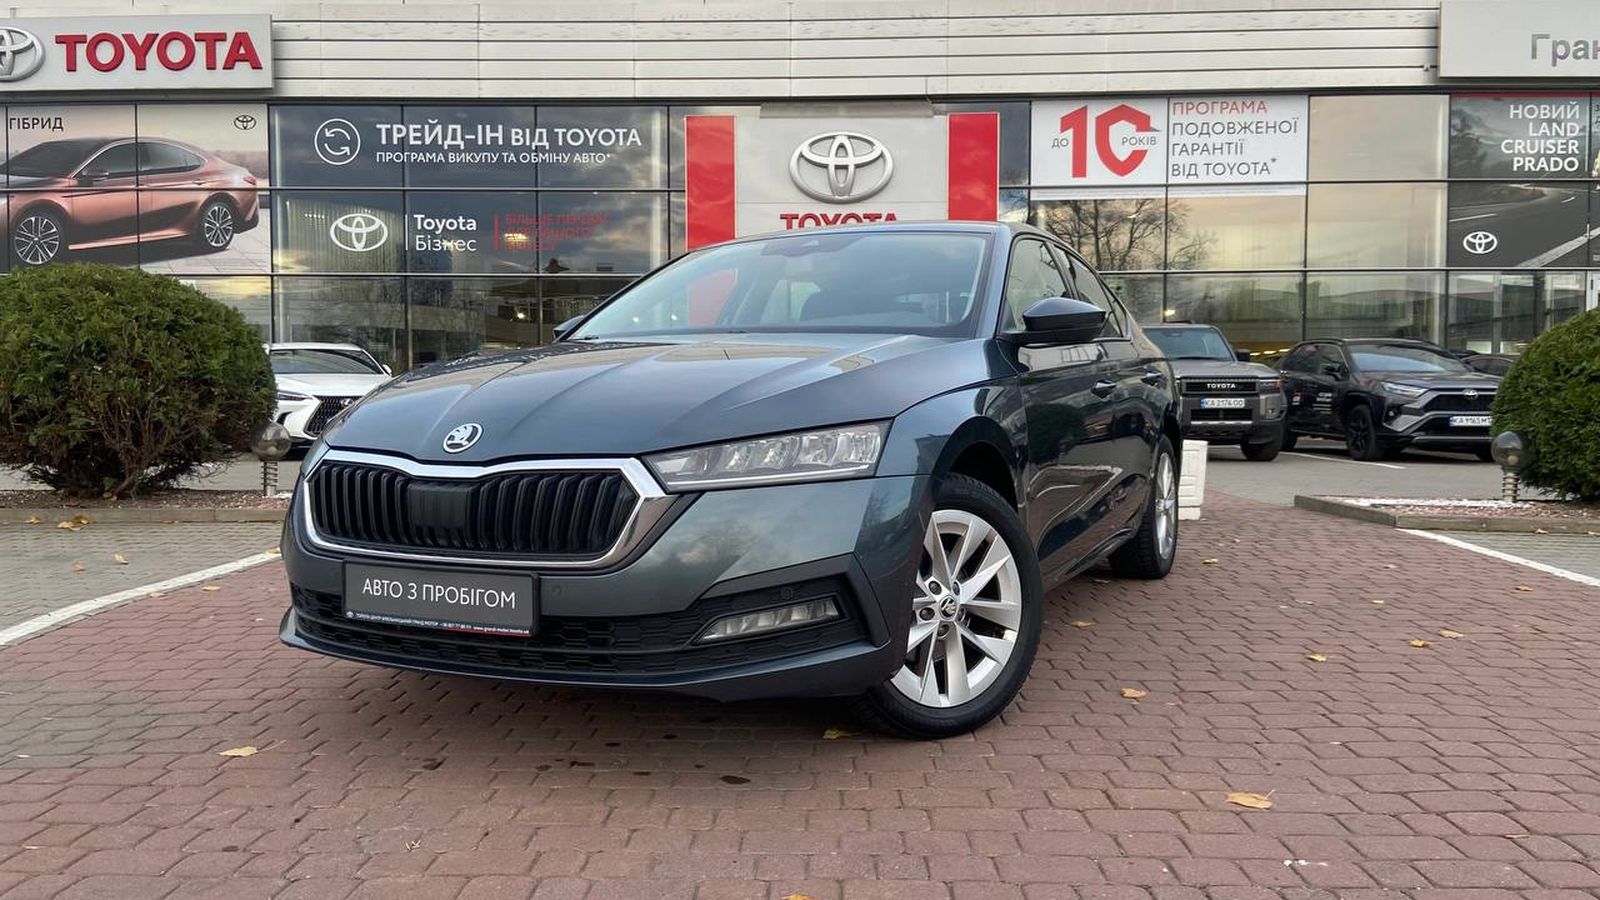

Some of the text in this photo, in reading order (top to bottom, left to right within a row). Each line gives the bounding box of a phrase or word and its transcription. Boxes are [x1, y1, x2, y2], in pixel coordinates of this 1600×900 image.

[55, 32, 263, 71] TOYOTA
[1172, 100, 1268, 115] ПРОГРАМА
[1509, 101, 1580, 119] НОВИЙ
[9, 116, 64, 132] ГІБРИД
[1172, 117, 1300, 137] ПОДОВЖЕНОЇ
[1528, 122, 1579, 137] LAND
[376, 119, 642, 150] ТРЕЙД-ІН ВІД TOYOTA
[1051, 103, 1157, 178] ДО 10 РОКІВ
[1172, 139, 1245, 156] ГАРАНТІЇ
[1500, 139, 1579, 154] CRUISER
[376, 151, 445, 163] ПРОГРАМА
[448, 151, 500, 163] ВИКУПУ
[502, 152, 517, 163] ТА
[519, 152, 571, 163] ОБМІНУ
[1512, 156, 1579, 172] PRADO
[1171, 163, 1199, 179] ВІД
[413, 214, 477, 234] Toyota
[415, 236, 477, 251] Бізнес
[362, 578, 403, 598] АВТО
[422, 584, 516, 609] ПРОБІГОМ
